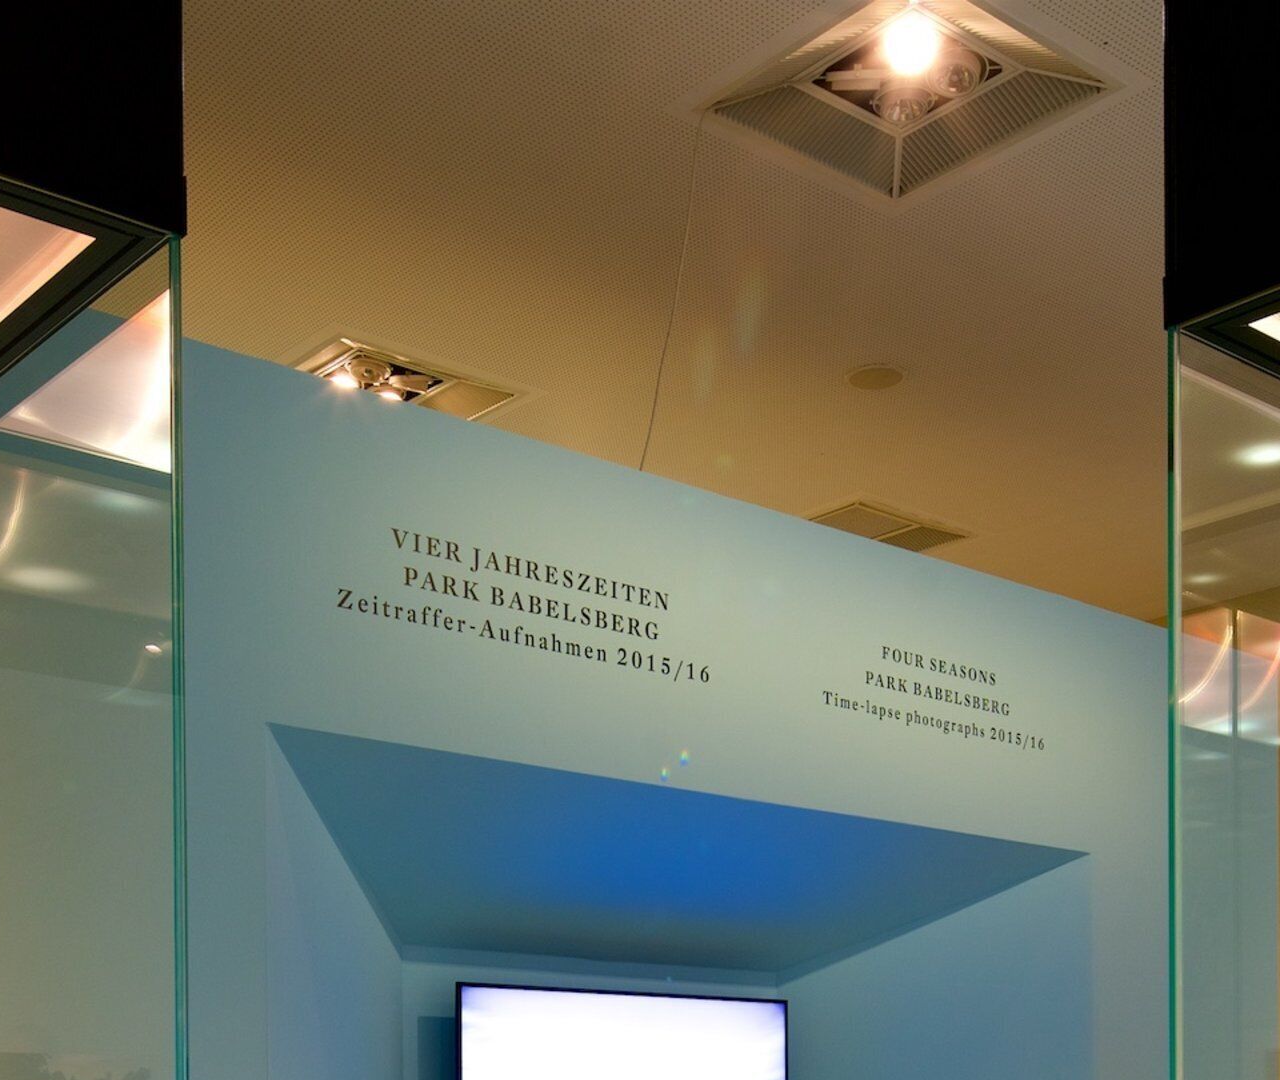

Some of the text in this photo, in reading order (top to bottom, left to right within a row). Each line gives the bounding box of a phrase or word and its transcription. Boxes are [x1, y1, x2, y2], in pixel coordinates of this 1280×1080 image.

[391, 527, 670, 611] VIER JAHRESZEITEN
[336, 587, 710, 683] Zeitraffer-Aufnahmen 2015/16
[403, 566, 659, 641] PARK BABELSBERG
[865, 670, 1010, 717] PARK BABELSBERG
[881, 646, 997, 686] FOUR SEASONS
[822, 690, 1046, 751] Time-lapse photographs 2015/16
